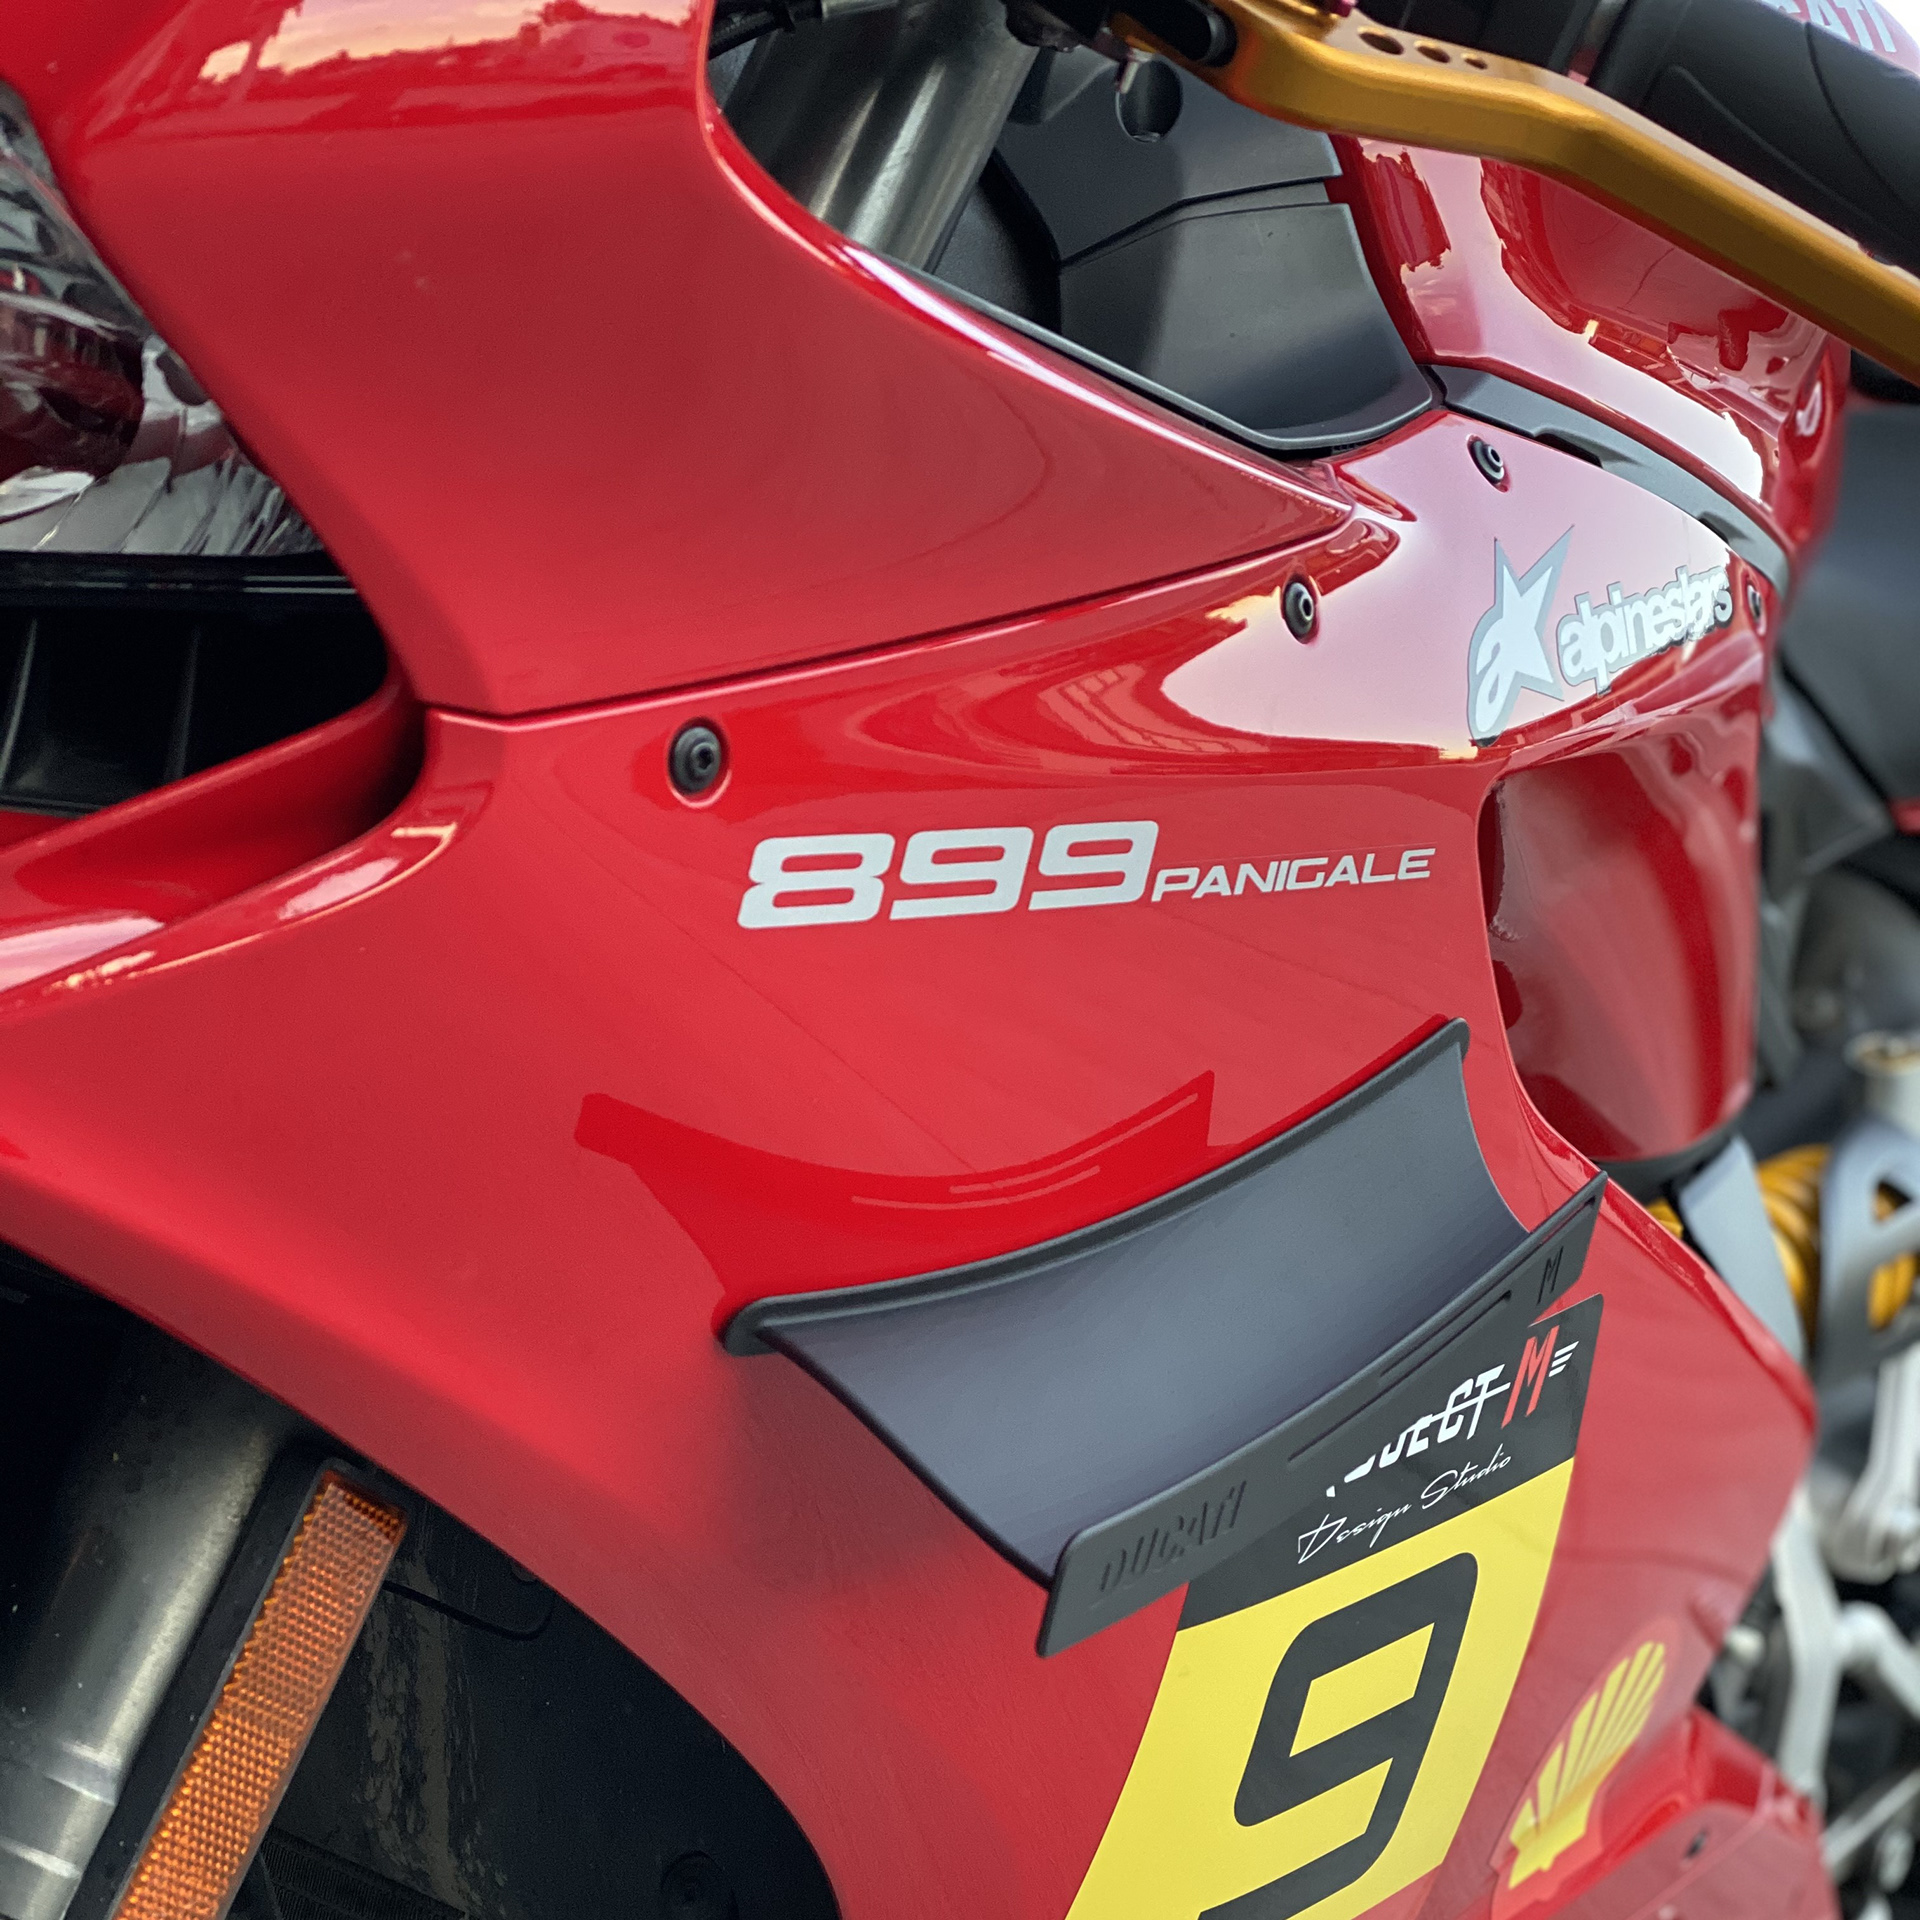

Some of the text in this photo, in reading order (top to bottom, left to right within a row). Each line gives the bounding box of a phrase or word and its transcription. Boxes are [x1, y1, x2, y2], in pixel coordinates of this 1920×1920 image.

[1556, 565, 1734, 697] alpinestars
[737, 819, 1437, 929] 899 PANIGALE
[1298, 1443, 1512, 1564] Design Studio
[1198, 1551, 1479, 1920] 9
